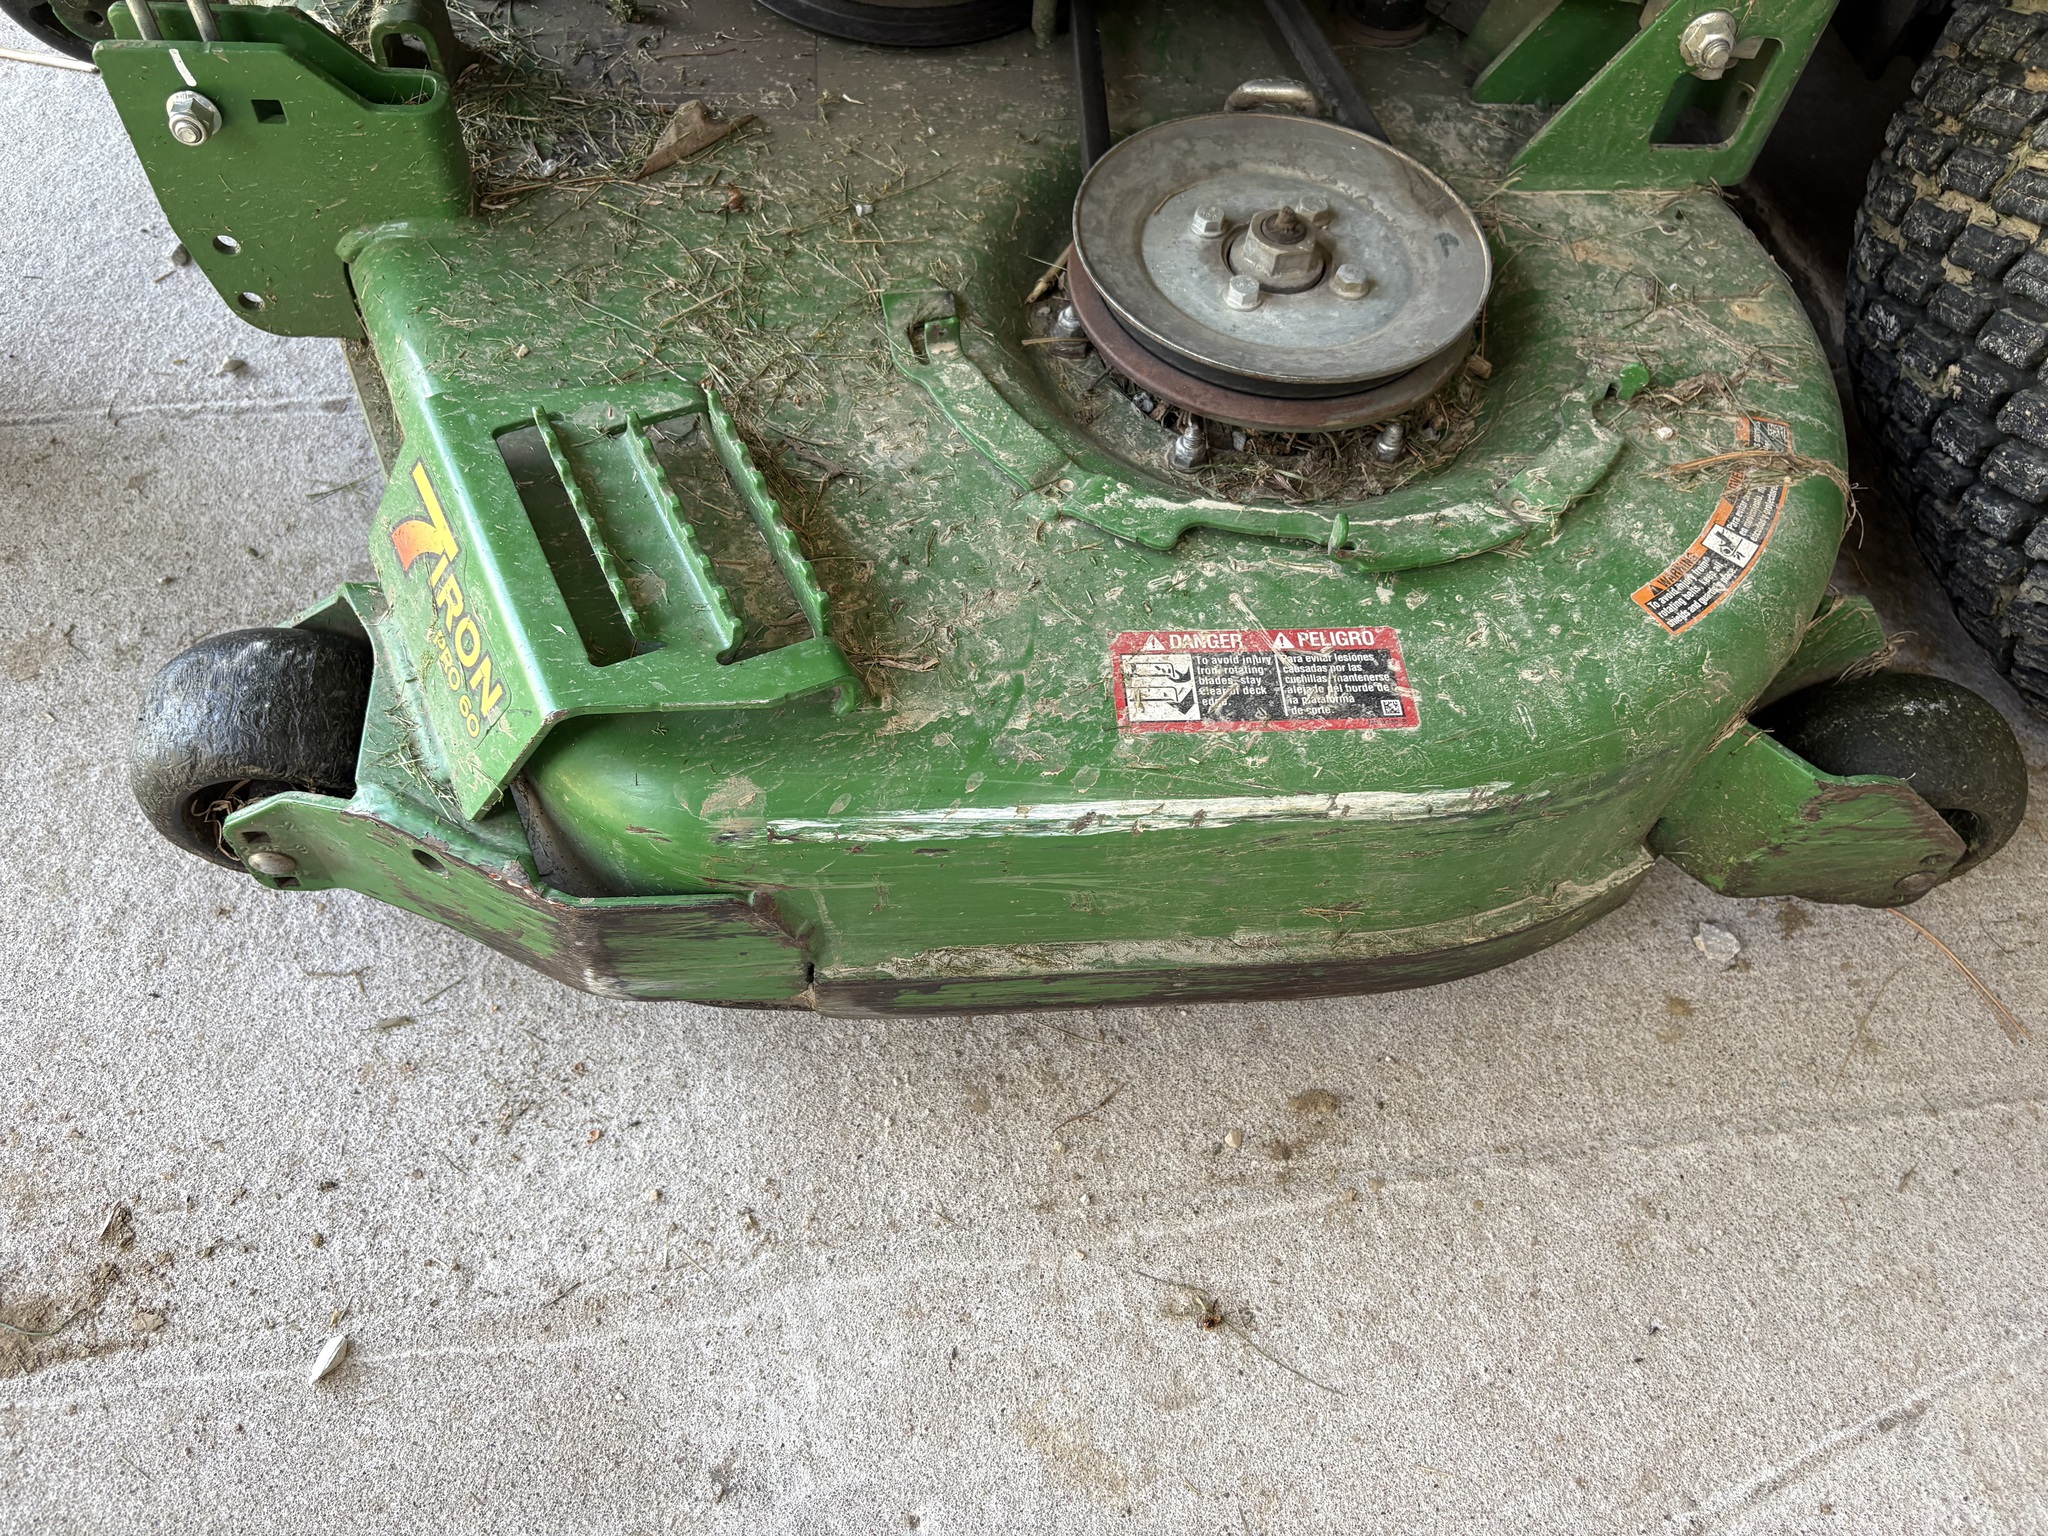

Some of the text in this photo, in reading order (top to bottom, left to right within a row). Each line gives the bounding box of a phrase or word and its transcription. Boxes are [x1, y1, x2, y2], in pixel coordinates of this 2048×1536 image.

[1726, 517, 1741, 531] Para
[1735, 500, 1748, 518] evitar
[1657, 552, 1698, 587] WARNING
[1647, 601, 1661, 610] To
[1658, 588, 1679, 604] avoid
[1692, 560, 1710, 576] from
[1658, 598, 1687, 618] rotating
[1699, 570, 1717, 586] keep
[1713, 561, 1723, 571] all
[1667, 608, 1691, 628] shields
[1688, 600, 1702, 613] and
[1169, 634, 1243, 649] DANGER
[1297, 630, 1376, 647] PELIGRO
[1196, 654, 1272, 666] To avoid injury
[1334, 653, 1375, 662] lesiones
[1224, 666, 1265, 676] rotating
[1283, 663, 1363, 674] causadas por las
[433, 629, 480, 738] PRO 60
[1240, 677, 1262, 686] stay
[1345, 683, 1375, 692] borde
[1376, 684, 1390, 692] de
[1243, 686, 1268, 695] deck
[1291, 706, 1303, 715] de
